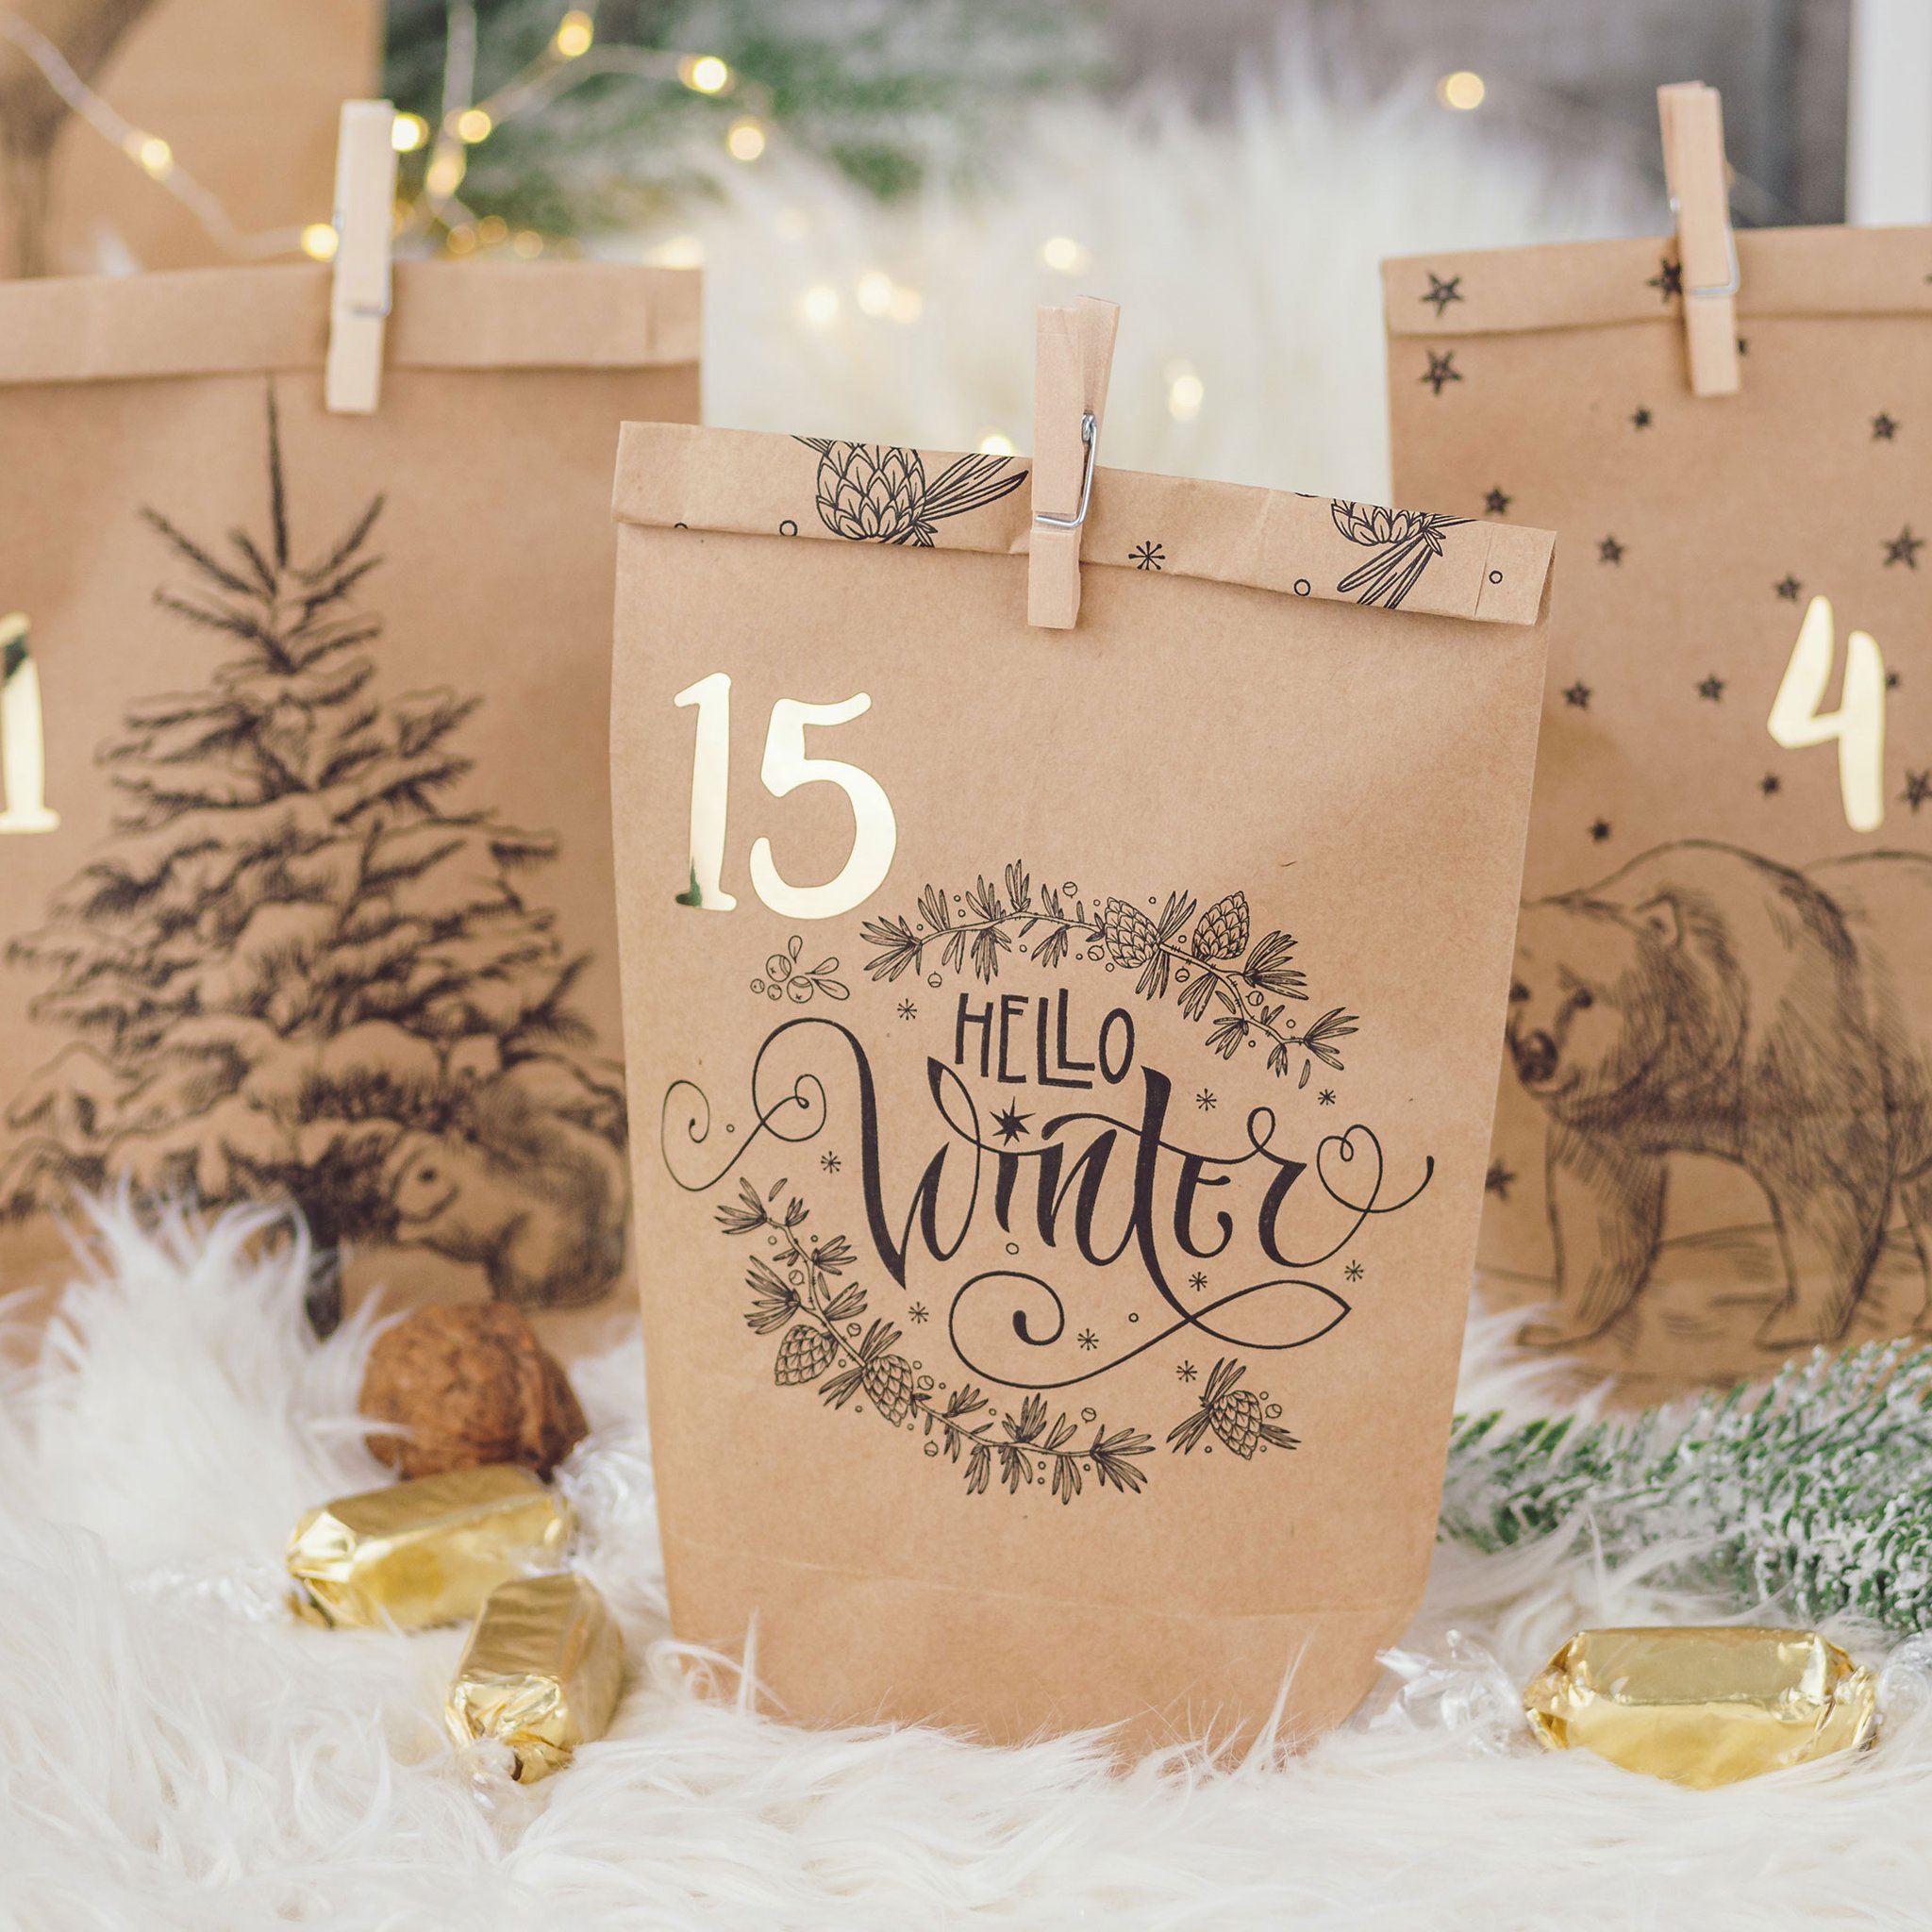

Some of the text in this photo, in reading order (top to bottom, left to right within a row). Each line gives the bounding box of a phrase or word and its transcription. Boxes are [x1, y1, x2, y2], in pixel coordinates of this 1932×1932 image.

[673, 672, 897, 920] 15
[1767, 594, 1886, 833] 4
[955, 988, 1136, 1090] HELLO
[661, 1017, 1435, 1389] Winter
